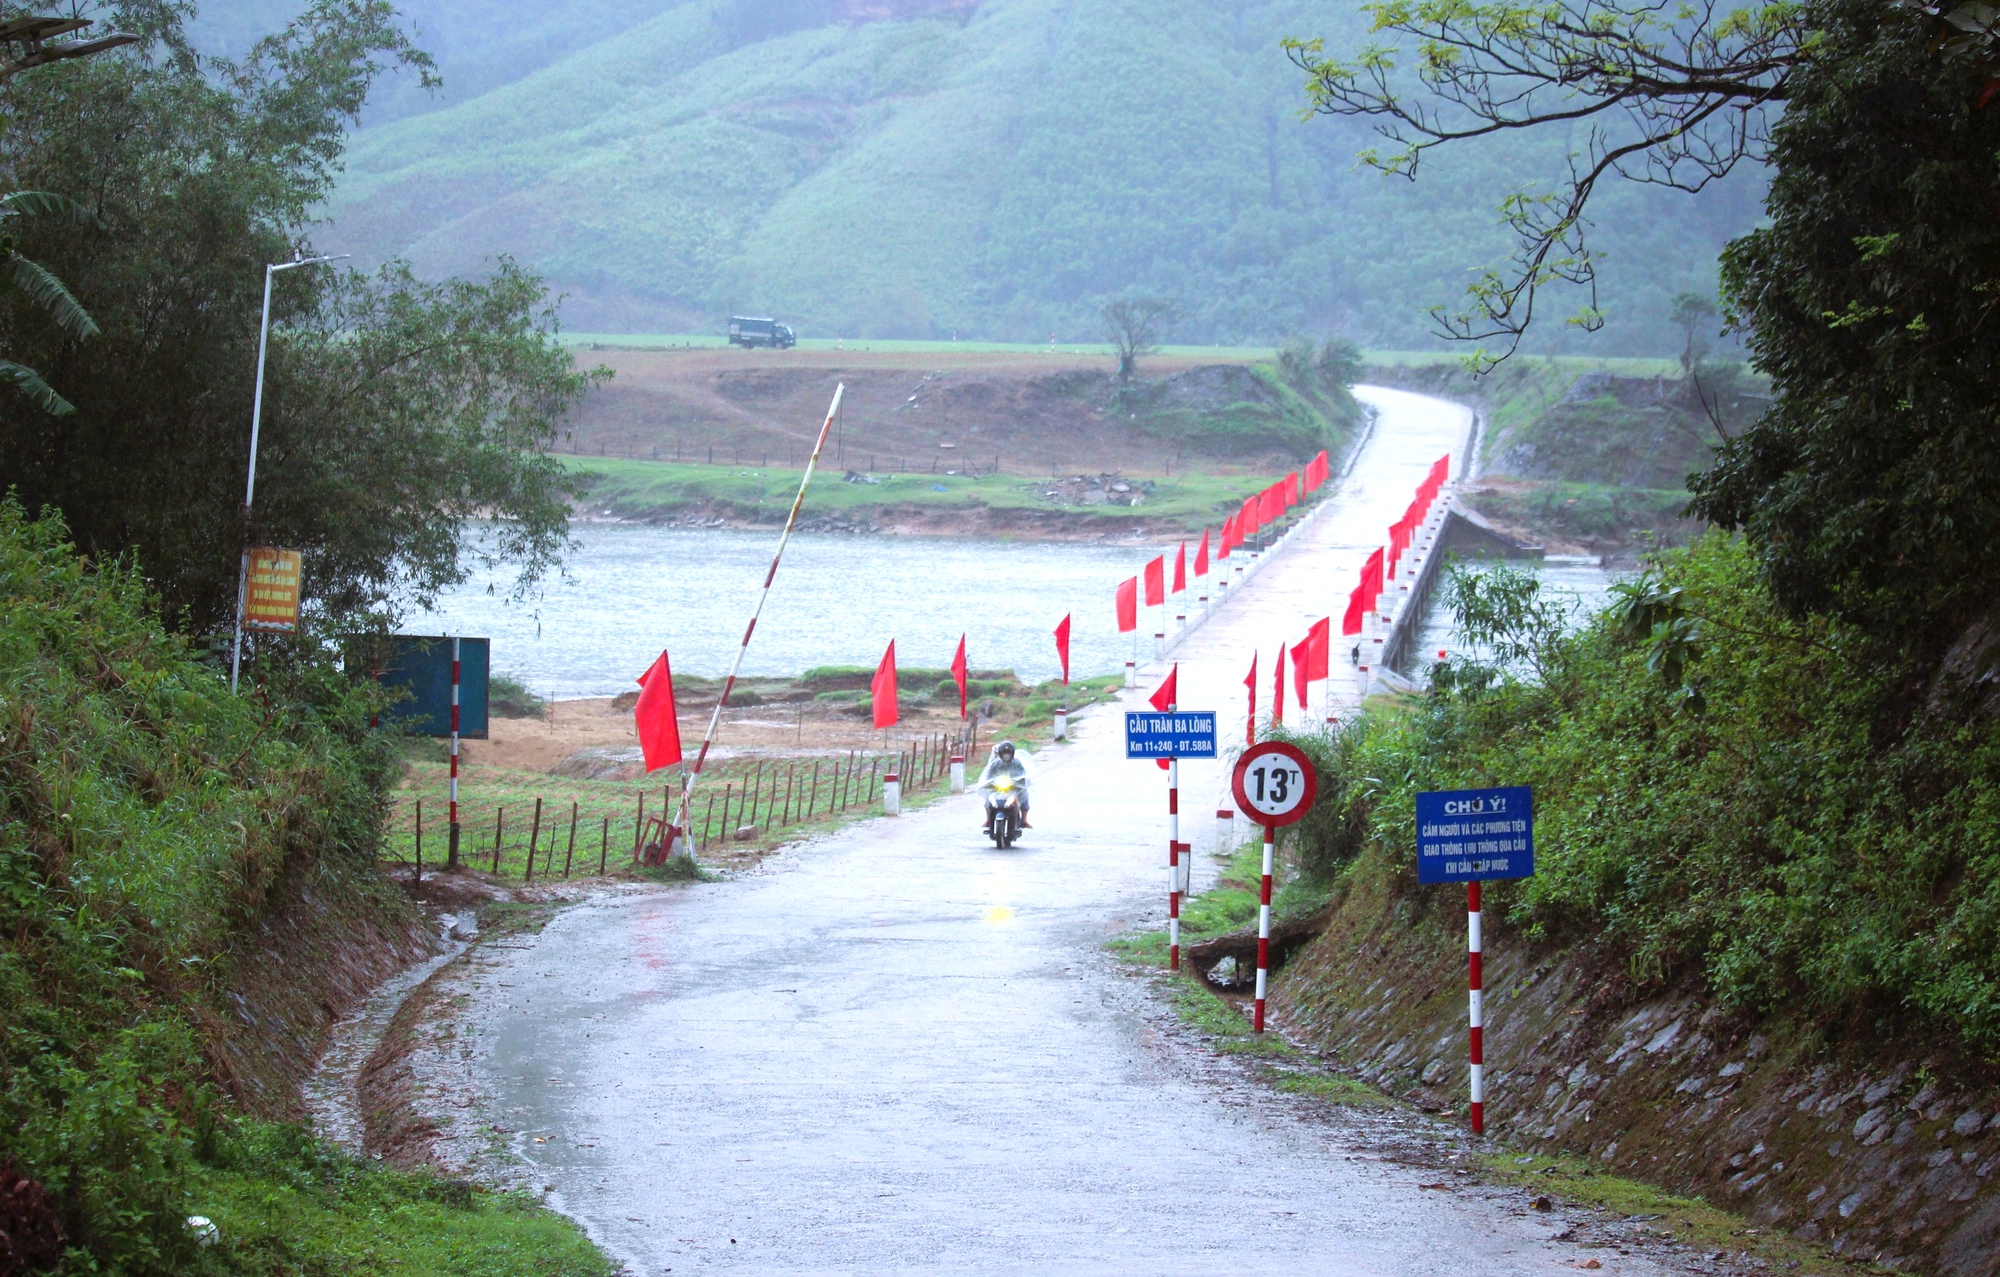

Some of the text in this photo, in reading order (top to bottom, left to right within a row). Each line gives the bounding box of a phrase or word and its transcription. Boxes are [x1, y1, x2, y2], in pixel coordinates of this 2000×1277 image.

[1129, 714, 1212, 734] CẦU TRÀN BA LÒNG
[1130, 741, 1143, 752] Km
[1144, 741, 1173, 752] 11+240
[1179, 740, 1212, 752] ĐT.588A
[1461, 821, 1470, 836] VÀ
[1471, 821, 1484, 835] CÁC
[1424, 843, 1440, 857] GIAO
[1499, 839, 1512, 853] QUA
[1445, 862, 1457, 874] KHI
